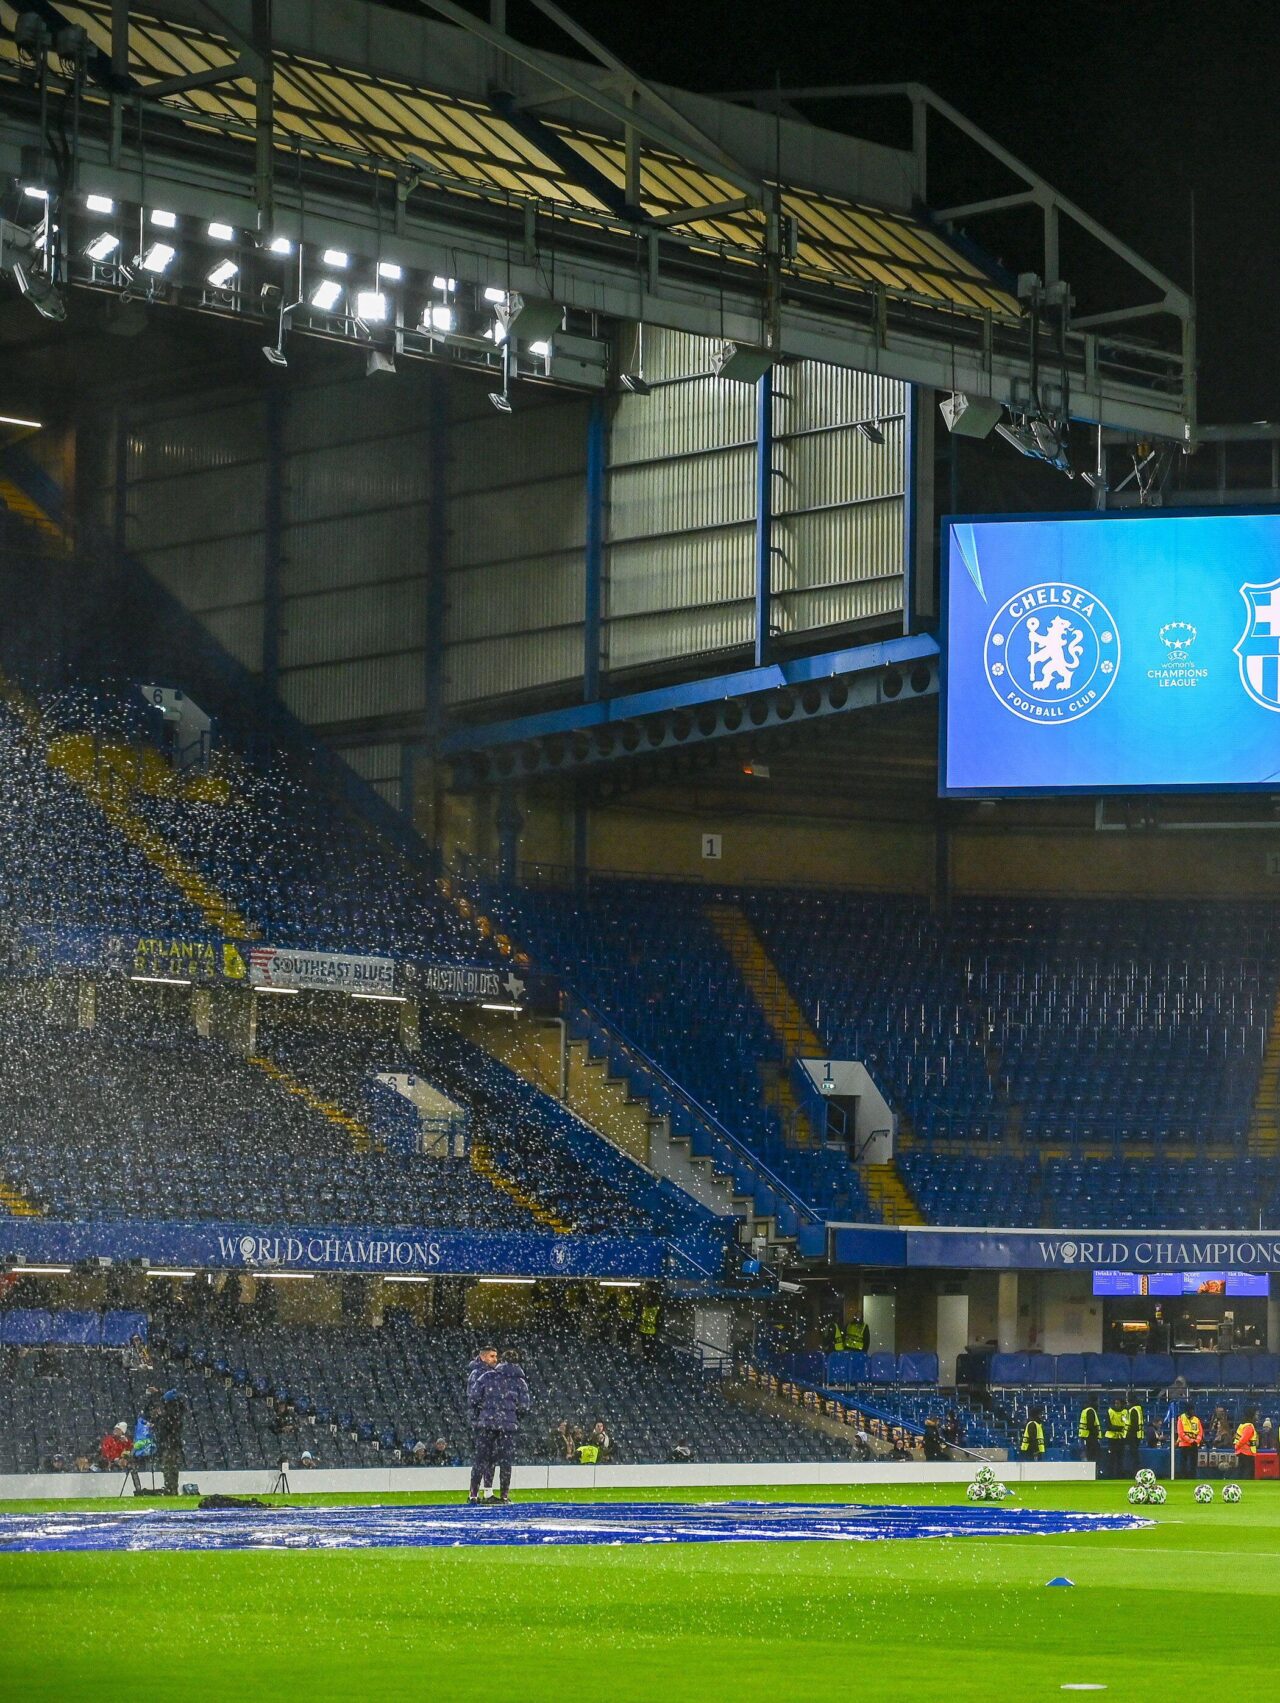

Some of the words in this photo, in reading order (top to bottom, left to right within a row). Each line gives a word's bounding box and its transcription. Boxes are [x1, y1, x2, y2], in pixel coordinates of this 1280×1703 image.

[1009, 588, 1095, 618] CHELSEA
[1168, 651, 1187, 660] UEFA
[1147, 669, 1208, 678] CHAMPIONS
[1159, 679, 1197, 687] LEAGUE
[153, 688, 163, 705] 6
[1007, 691, 1064, 717] FOOTBALL
[1069, 690, 1097, 712] CLUB
[706, 838, 717, 857] 1
[136, 938, 215, 960] ATLANTA
[272, 955, 352, 979] SOUTHEAST
[353, 963, 393, 982] BLUES
[424, 967, 467, 993] AUSTIN
[467, 971, 500, 996] BLUES
[823, 1062, 834, 1081] 1
[218, 1236, 303, 1262] WORLD
[307, 1239, 441, 1266] CHAMPIONS
[1038, 1241, 1129, 1264] WORLD
